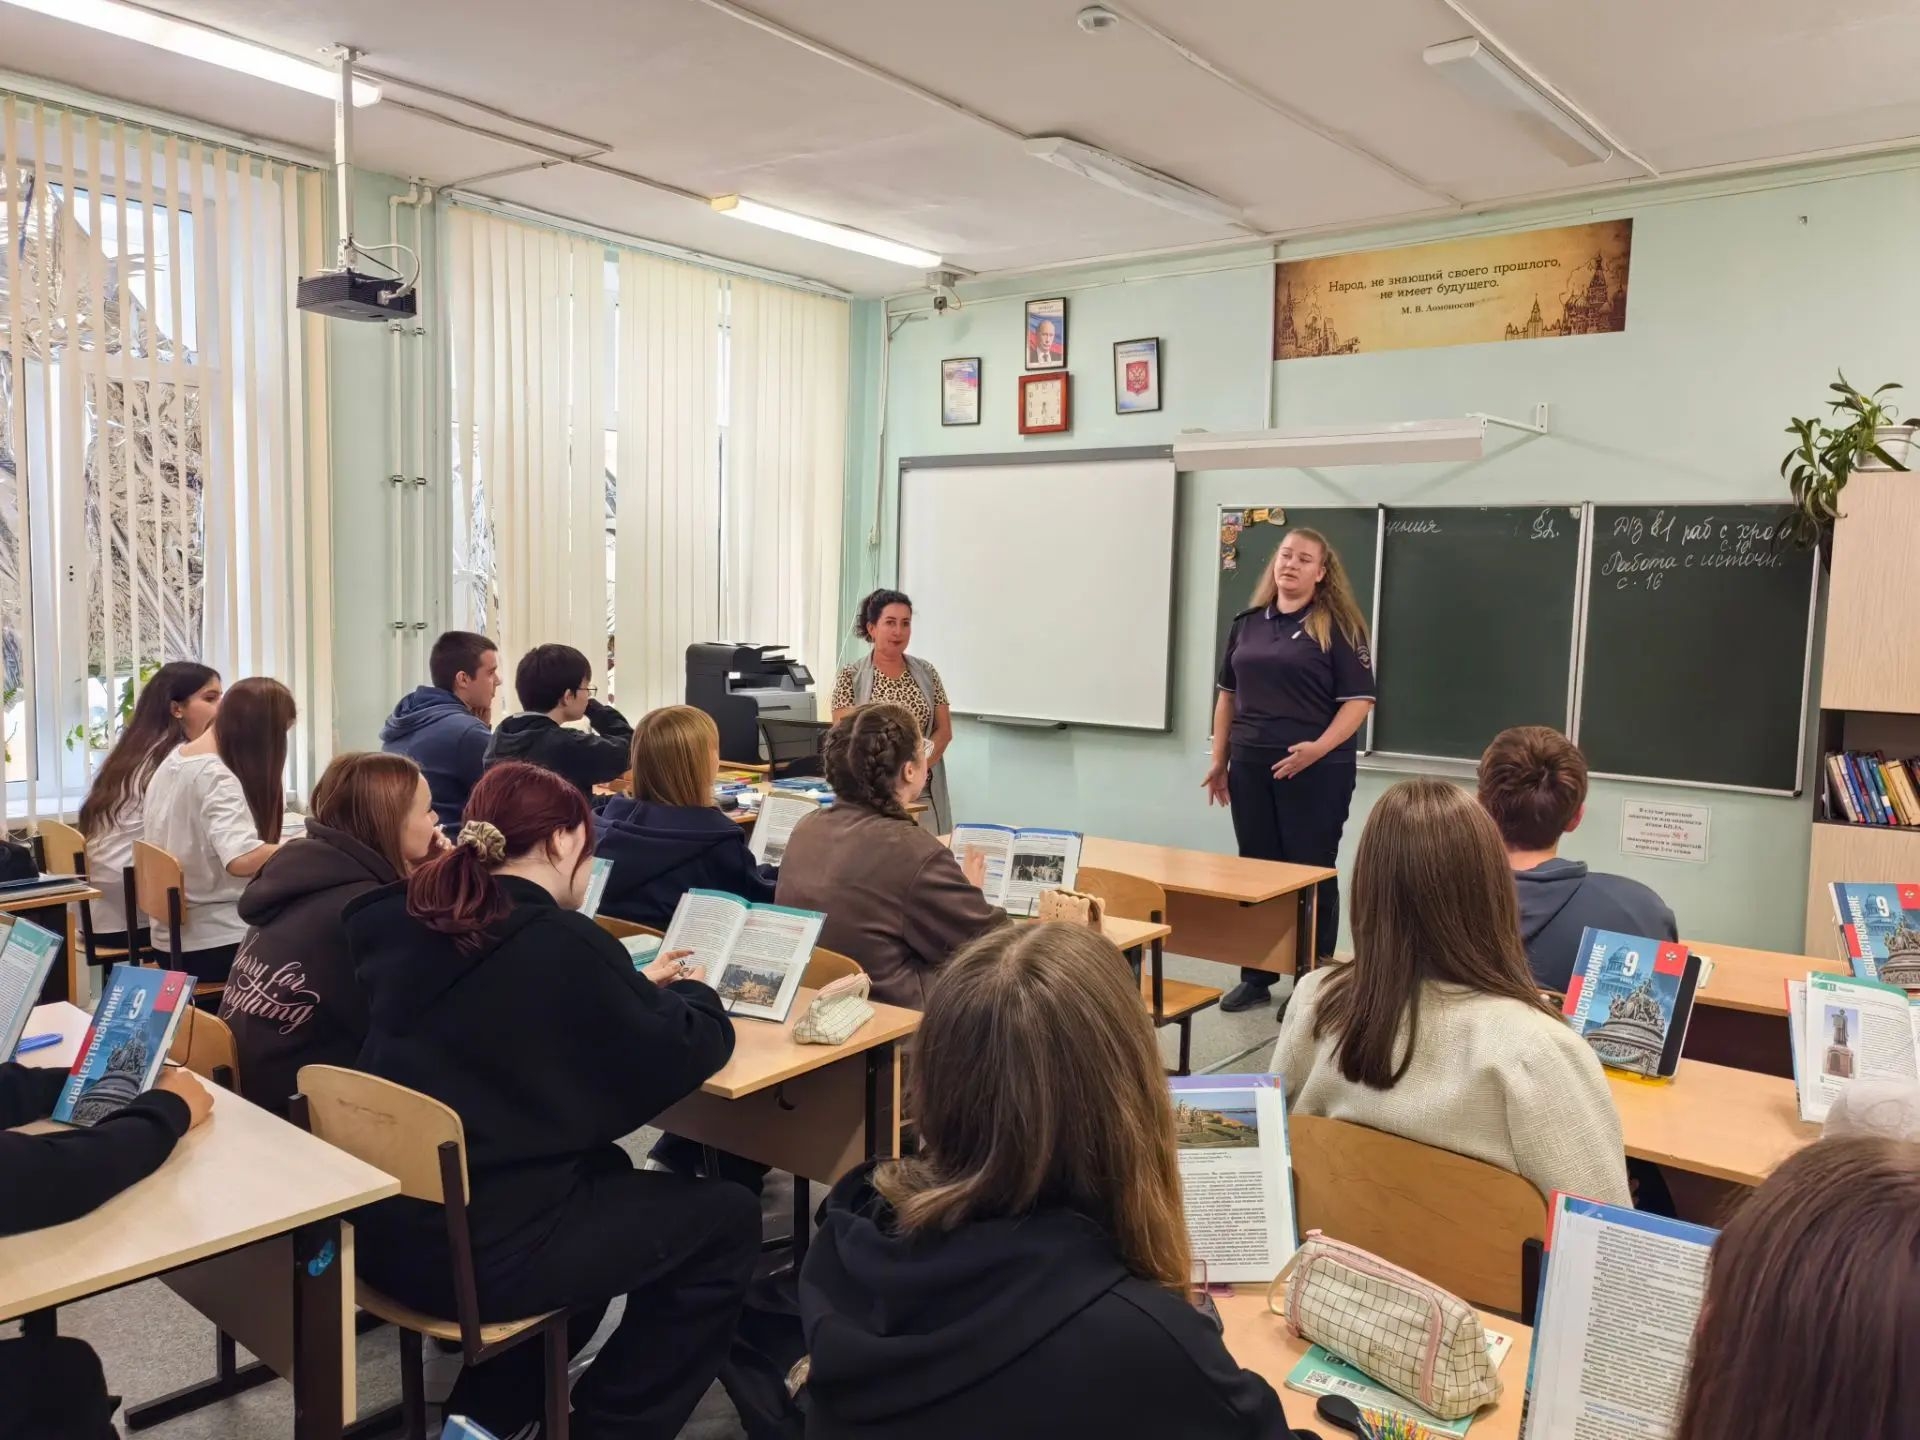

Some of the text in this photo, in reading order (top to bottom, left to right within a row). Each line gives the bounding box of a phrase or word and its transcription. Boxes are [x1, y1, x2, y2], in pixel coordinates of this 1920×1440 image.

[1328, 258, 1561, 293] Народ, не знающий своего прошлого,
[1379, 279, 1499, 300] не имеет будущего.
[1602, 551, 1678, 576] Работа
[1684, 554, 1694, 568] с
[1876, 896, 1890, 917] 9
[1622, 951, 1639, 977] 9
[129, 988, 147, 1020] 9
[66, 983, 125, 1105] ОБЩЕСТВОЗНАНИЕ
